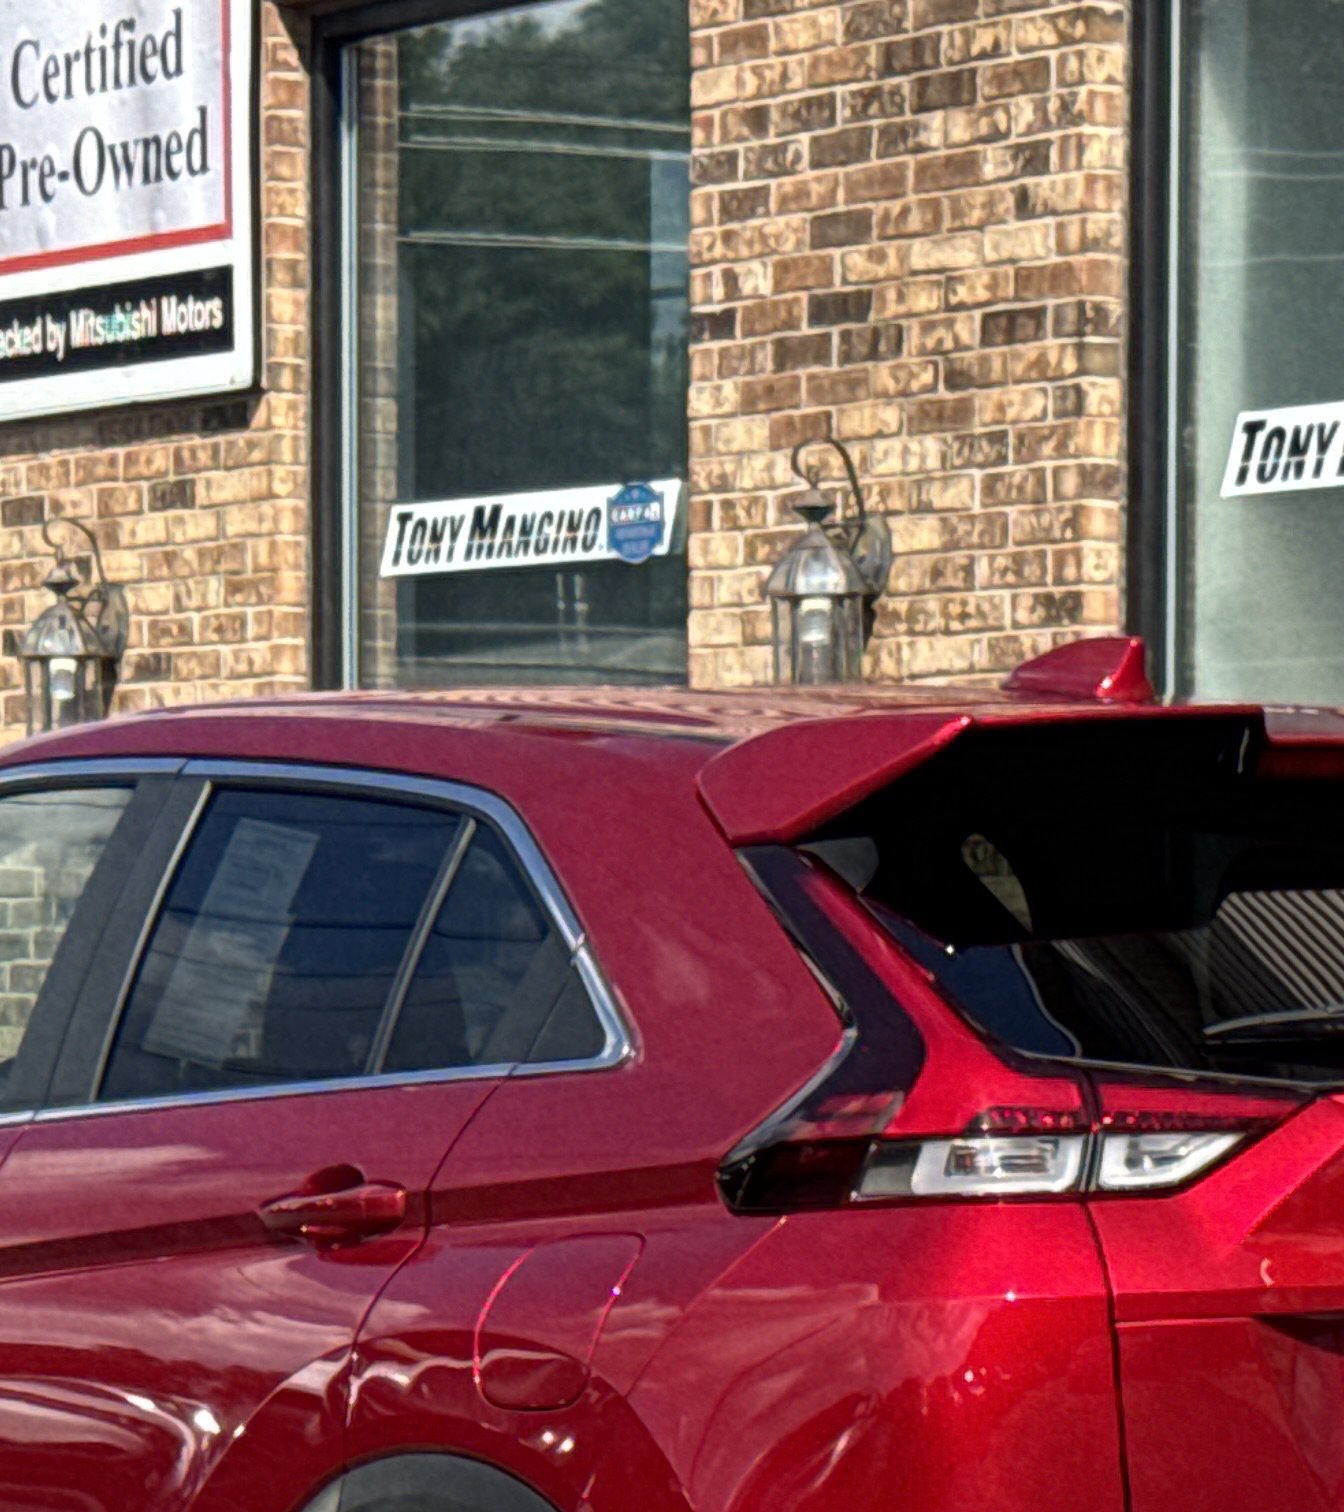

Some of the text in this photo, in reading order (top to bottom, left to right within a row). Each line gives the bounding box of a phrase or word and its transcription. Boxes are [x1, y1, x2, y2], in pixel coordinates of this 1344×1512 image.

[11, 7, 183, 109] Certified
[45, 313, 67, 362] by
[69, 299, 157, 350] Mitsubishi
[160, 294, 223, 336] Motors
[1235, 419, 1341, 487] TONY
[392, 503, 602, 567] TONY MANGINO
